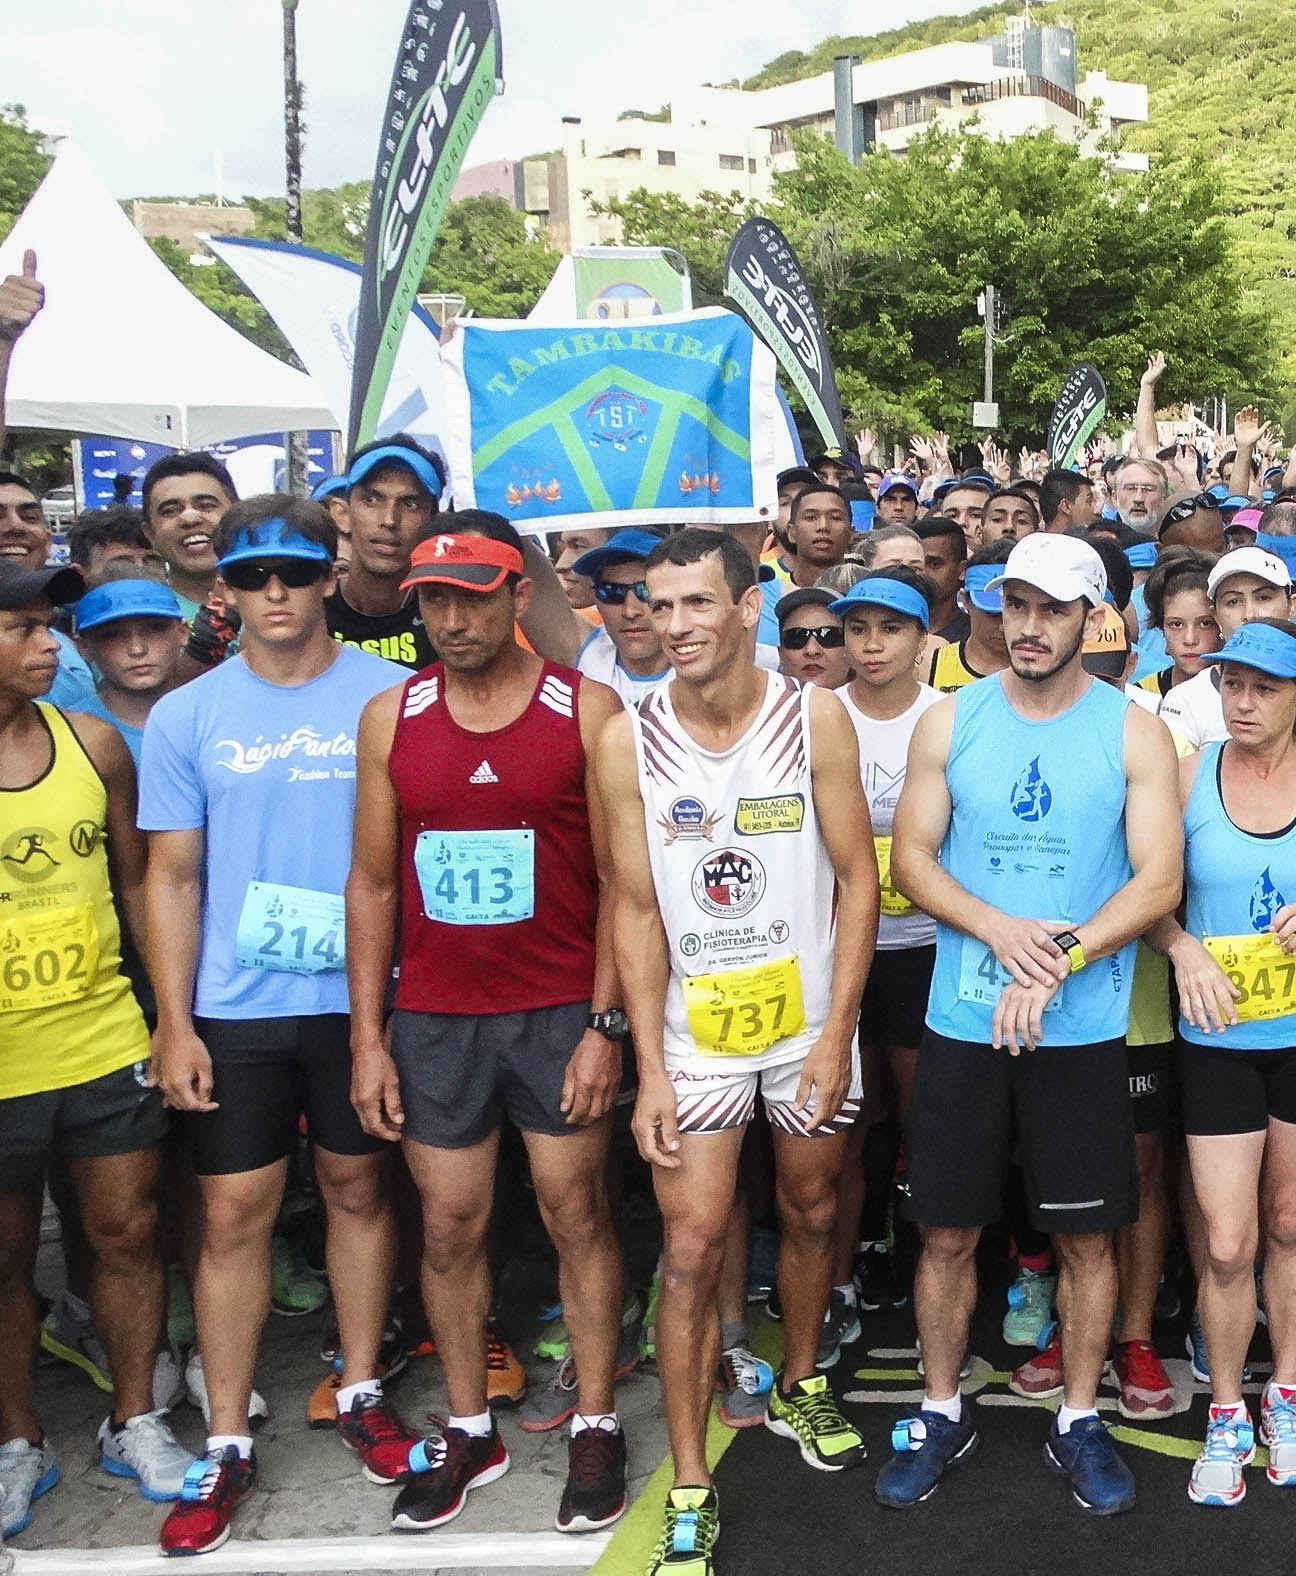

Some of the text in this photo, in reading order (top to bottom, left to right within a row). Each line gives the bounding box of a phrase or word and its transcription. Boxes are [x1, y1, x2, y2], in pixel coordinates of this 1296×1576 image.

[486, 330, 743, 396] TAMBAKIBAS
[740, 799, 799, 811] EMBALAGENS
[752, 809, 789, 820] LITORAL
[435, 867, 514, 905] 413
[703, 860, 752, 888] MAC
[259, 921, 339, 963] 214
[703, 926, 756, 940] CLÍNICA DE
[703, 934, 768, 950] FISIOTERAPIA
[3, 943, 87, 992] 602
[1226, 962, 1296, 1005] 847
[711, 994, 787, 1042] 737
